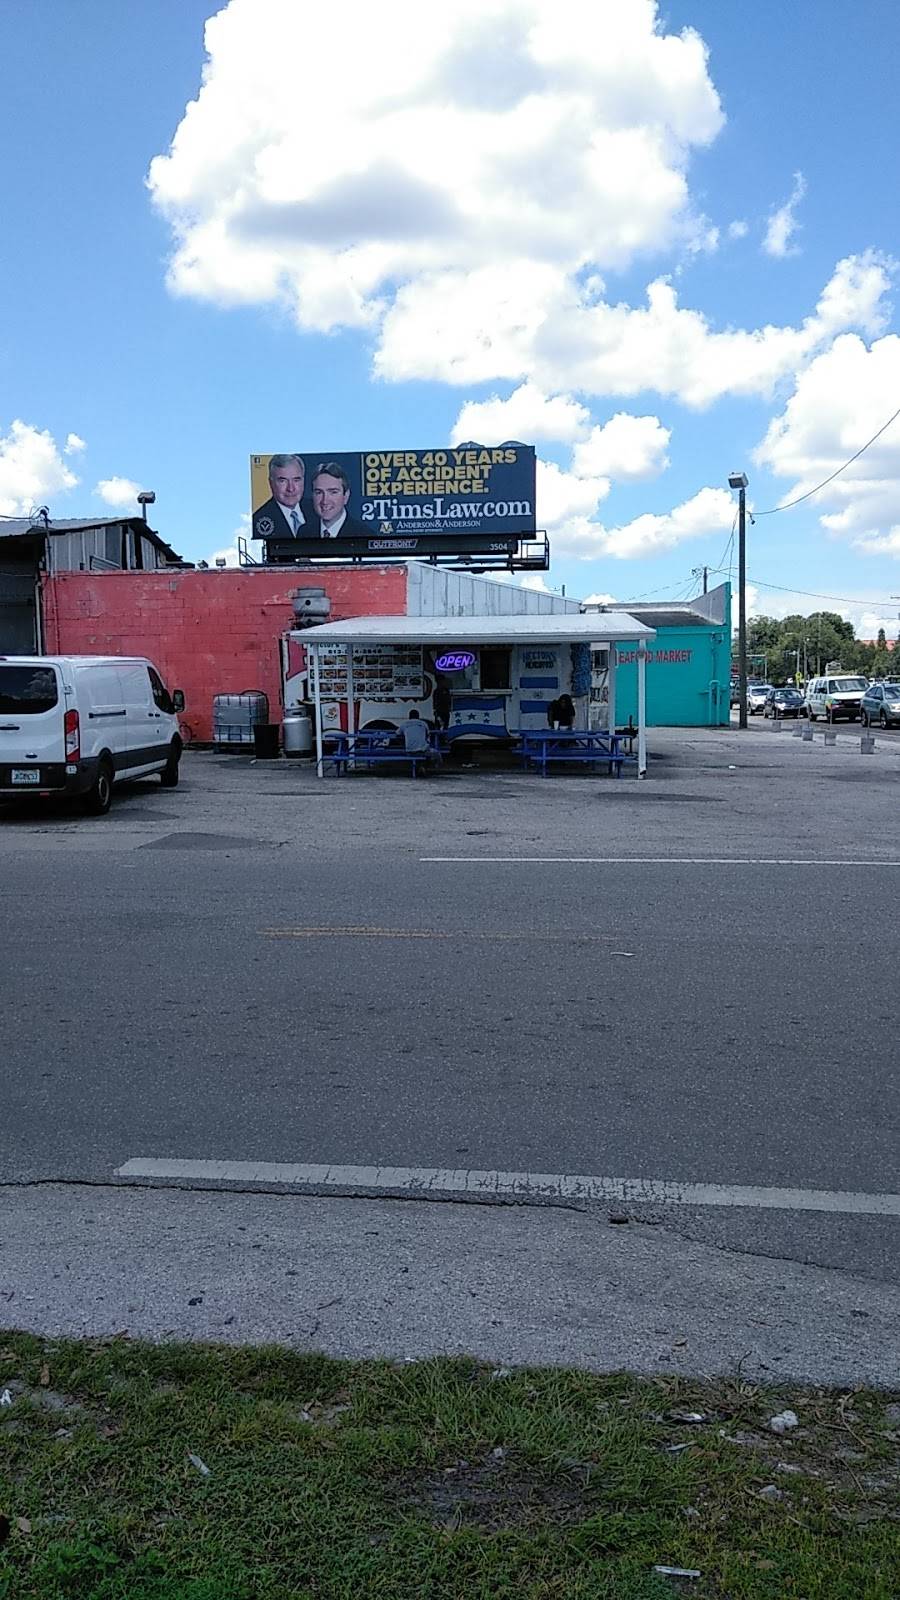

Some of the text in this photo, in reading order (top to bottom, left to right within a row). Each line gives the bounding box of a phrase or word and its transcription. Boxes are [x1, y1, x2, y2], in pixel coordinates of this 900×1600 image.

[365, 449, 517, 468] OVER 40 YEARS
[366, 464, 493, 482] OF ACCIDENT
[366, 479, 490, 497] EXPERIENCE.
[361, 497, 532, 521] 2TimsLaw.com
[373, 540, 412, 549] OUTFRONT
[489, 543, 508, 551] 3504
[438, 655, 471, 667] OPEN
[655, 649, 693, 663] MARKET
